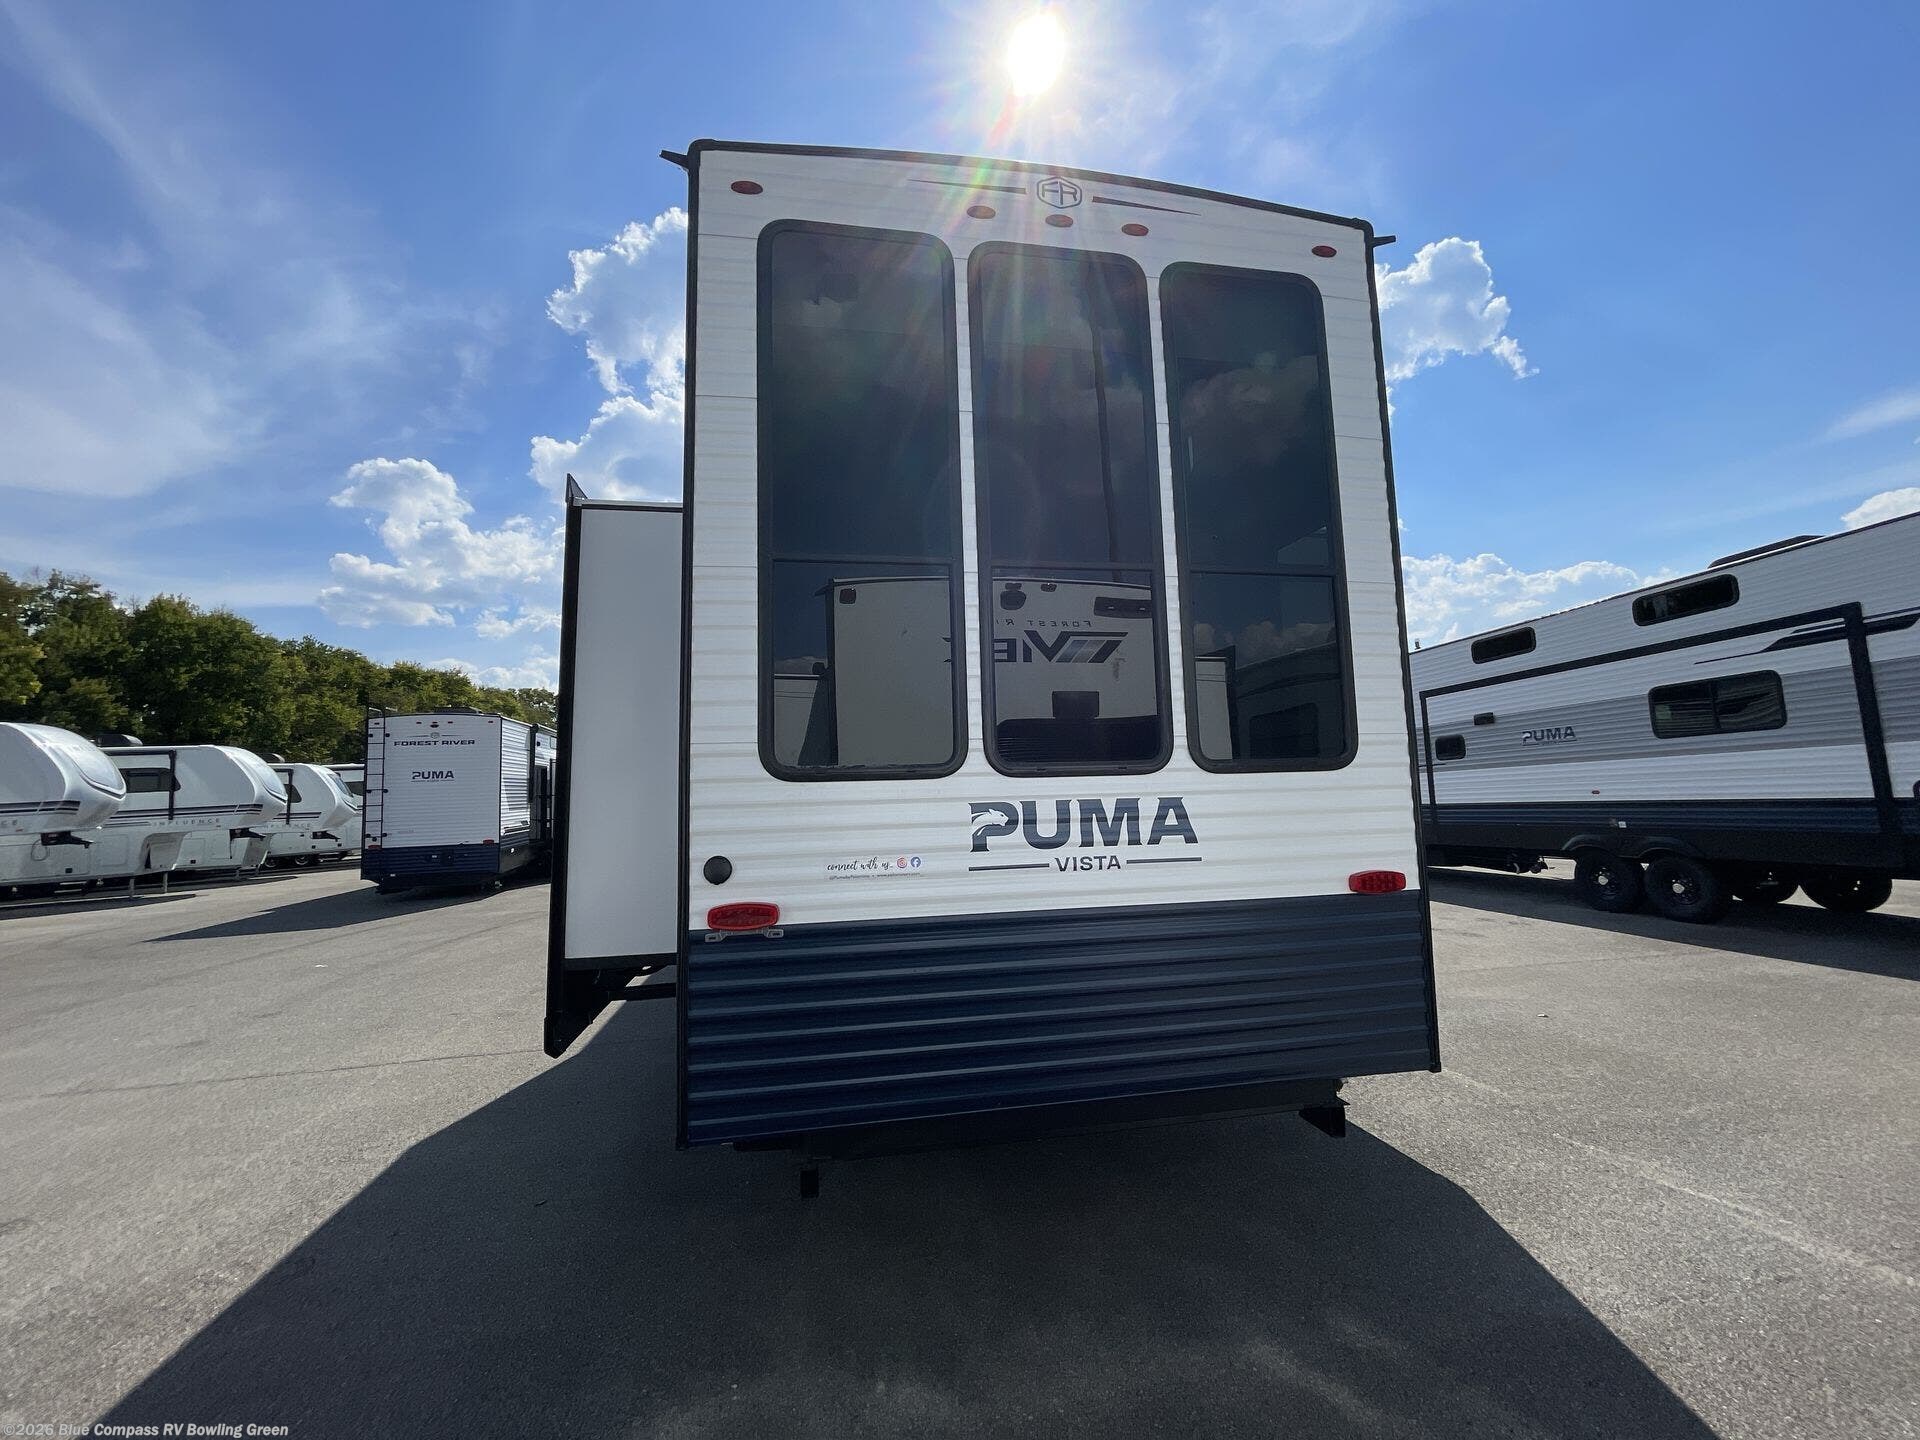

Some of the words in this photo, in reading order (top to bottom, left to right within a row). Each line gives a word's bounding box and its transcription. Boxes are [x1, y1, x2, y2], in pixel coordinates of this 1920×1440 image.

[1521, 726, 1577, 745] PUMA
[411, 770, 455, 780] PUMA
[968, 796, 1199, 853] PUMA
[827, 860, 858, 871] connect
[860, 857, 879, 870] with
[1054, 855, 1122, 872] VISTA
